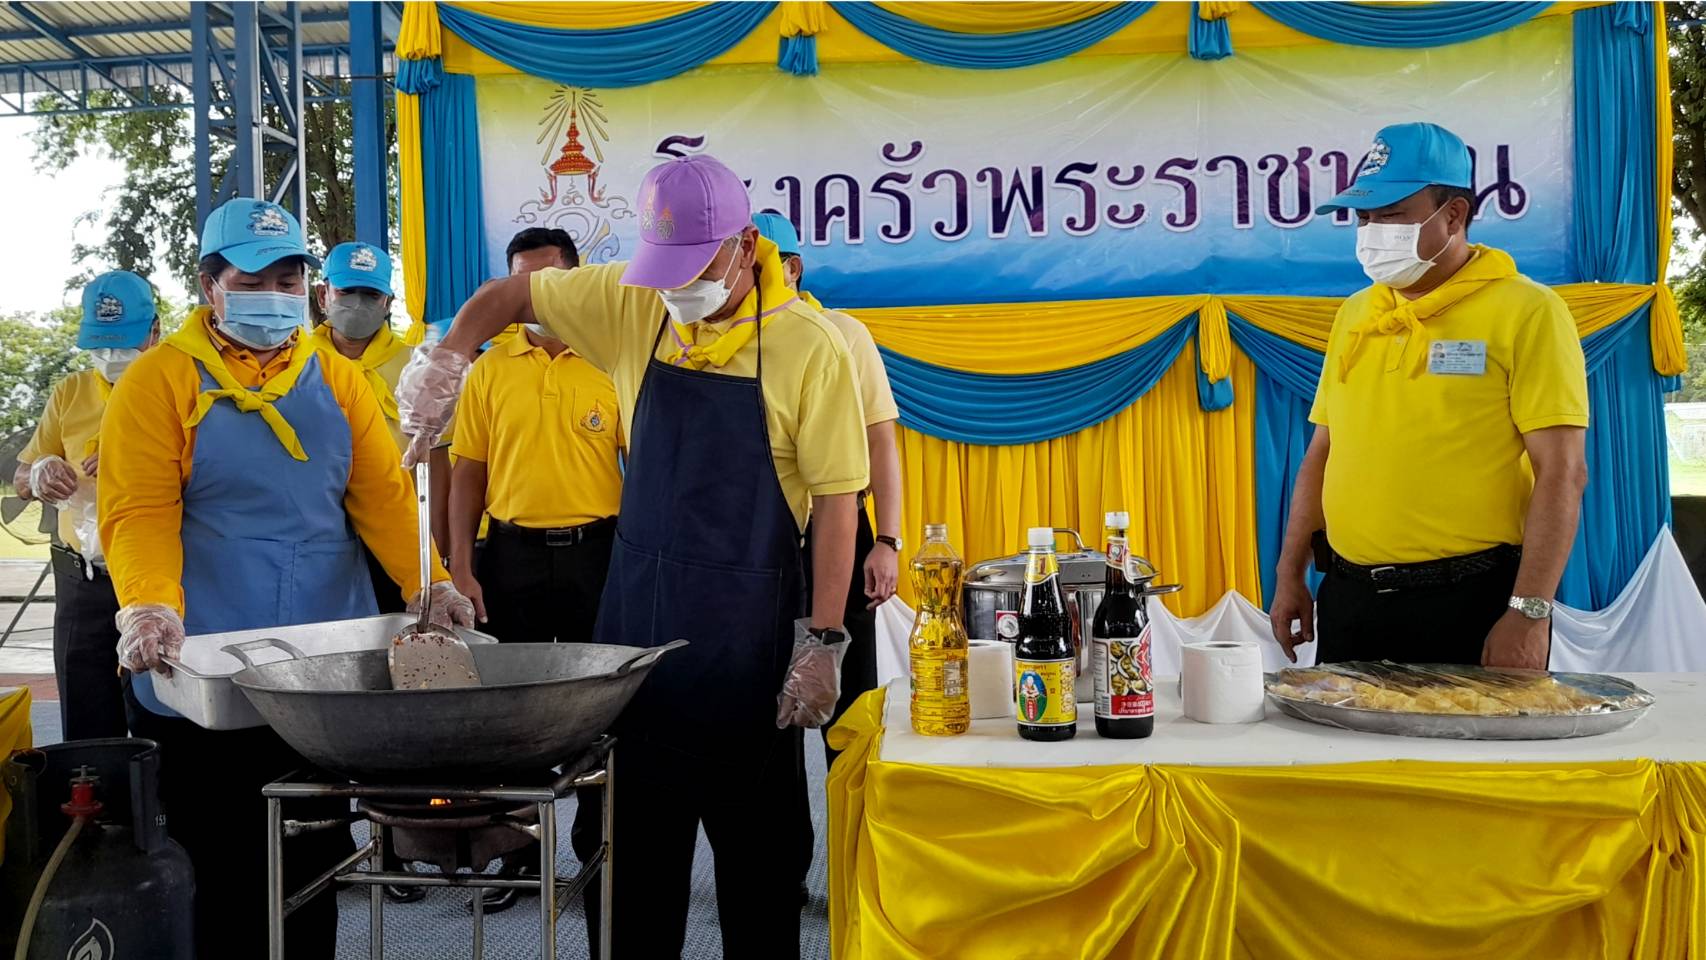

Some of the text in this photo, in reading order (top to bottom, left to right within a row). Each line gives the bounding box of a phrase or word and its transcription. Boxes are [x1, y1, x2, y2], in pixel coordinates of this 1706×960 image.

[656, 134, 1527, 244] งครัวพระราชทน
